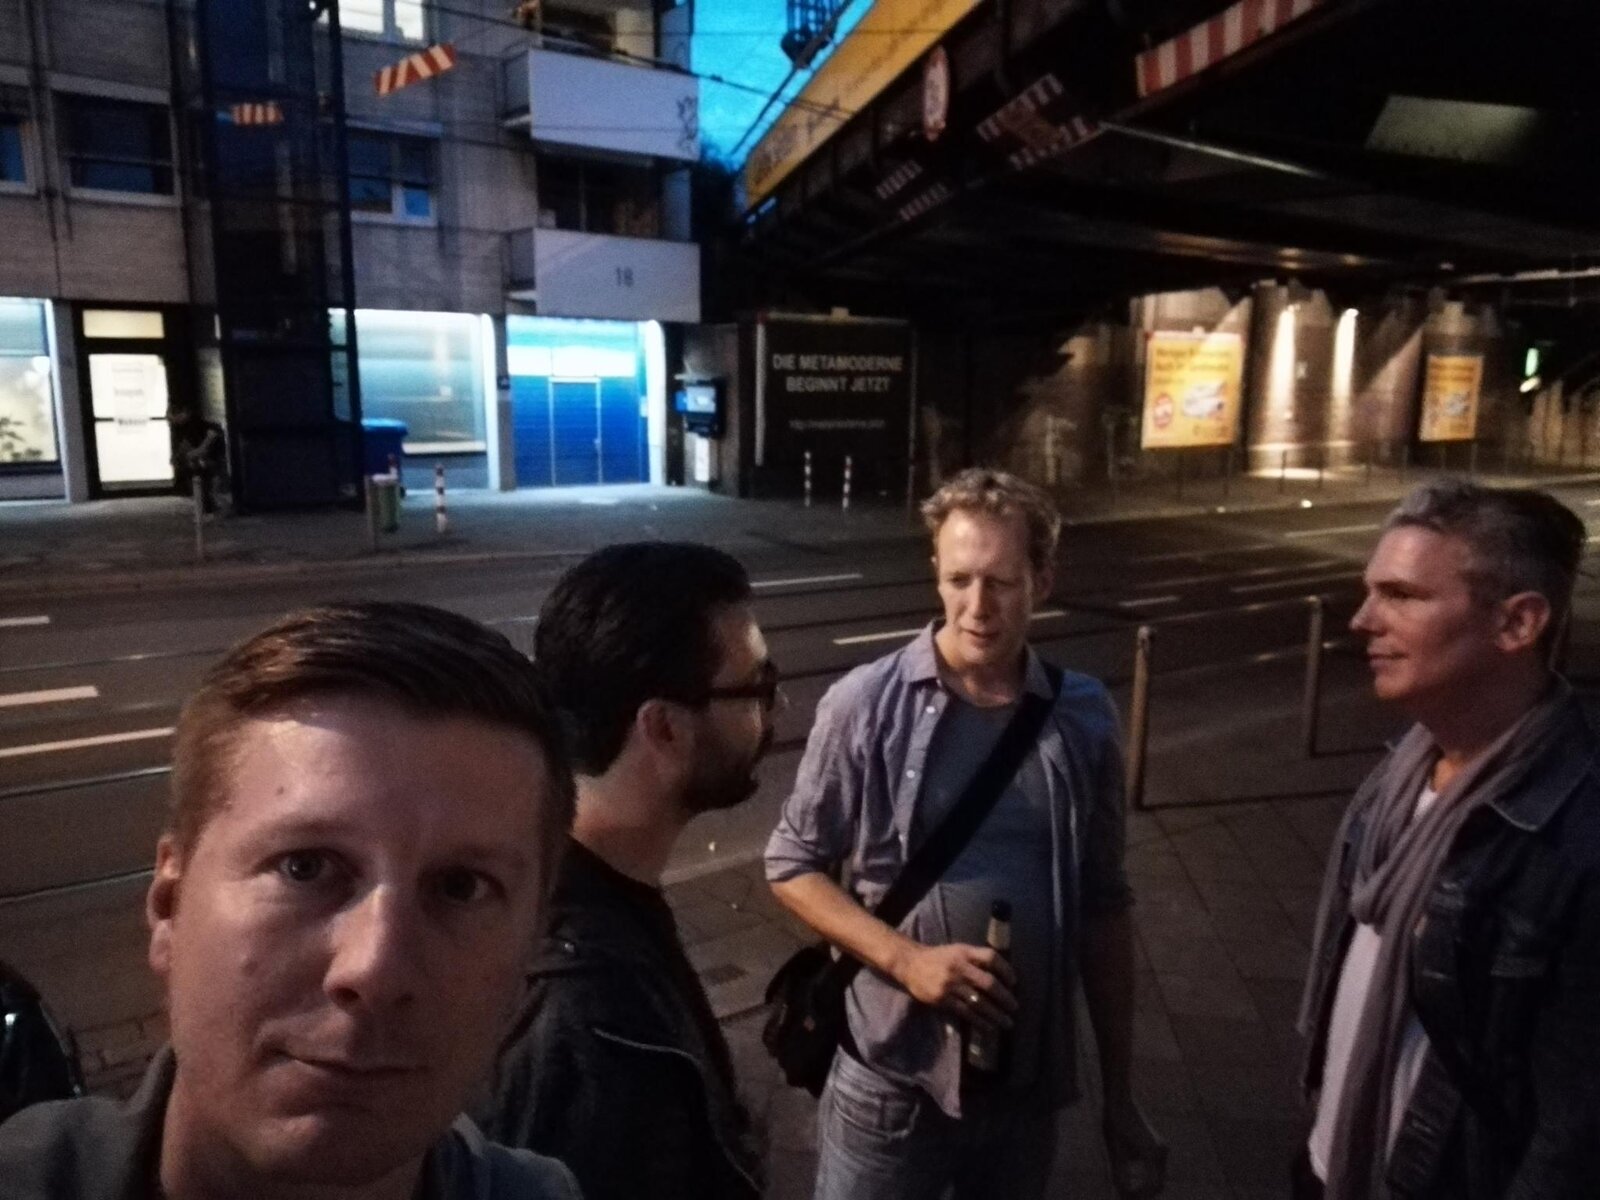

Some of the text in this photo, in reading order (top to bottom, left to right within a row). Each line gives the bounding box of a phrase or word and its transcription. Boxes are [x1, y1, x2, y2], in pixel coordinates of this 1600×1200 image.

[772, 353, 903, 371] DIE METAMODERNE
[786, 376, 891, 392] BEGINNT JETZT
